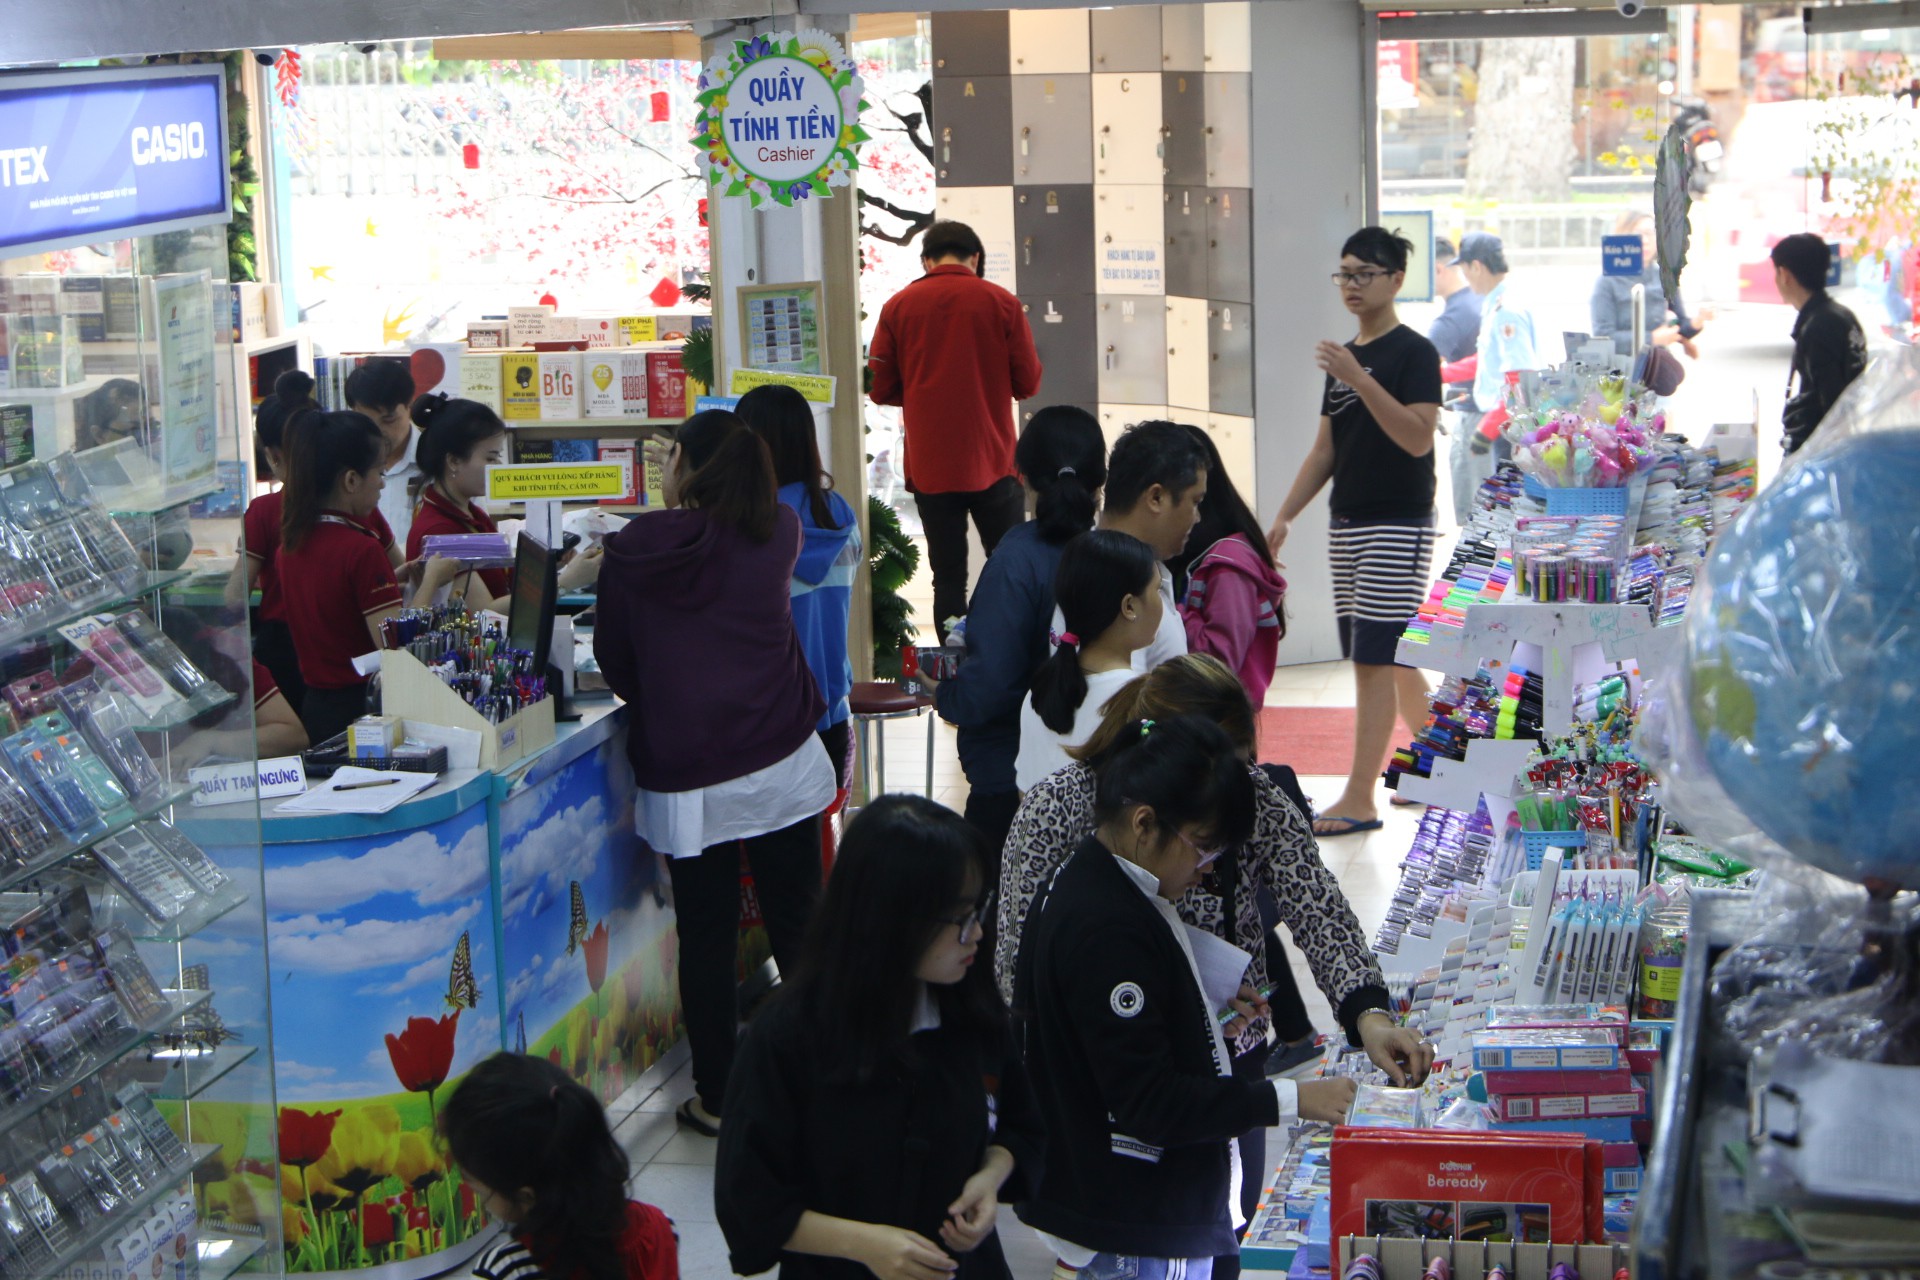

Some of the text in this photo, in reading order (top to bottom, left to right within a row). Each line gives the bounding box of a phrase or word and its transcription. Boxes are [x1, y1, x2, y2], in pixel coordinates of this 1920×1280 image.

[749, 66, 805, 107] QUẦY
[964, 81, 975, 97] A
[1120, 78, 1130, 93] C
[729, 104, 836, 142] TÍNH TIỀN
[131, 121, 206, 166] CASIO
[757, 146, 815, 162] Cashier
[1613, 257, 1632, 267] Pull
[1048, 300, 1058, 315] L
[1122, 301, 1134, 315] M
[596, 367, 609, 378] 25
[658, 377, 680, 398] 30
[495, 473, 511, 482] QUÝ
[513, 471, 540, 481] KHÁCH
[542, 472, 556, 480] VUI
[556, 471, 577, 480] LÒNG
[579, 468, 594, 479] XẾP
[595, 470, 616, 479] HÀNG
[528, 483, 547, 491] TÍNH
[199, 773, 228, 796] QUẦY
[259, 768, 299, 787] NGƯNG
[1427, 1173, 1487, 1192] Beready
[175, 1208, 197, 1233] CASIO
[151, 1228, 174, 1252] CASIO
[126, 1247, 149, 1273] CASIO
